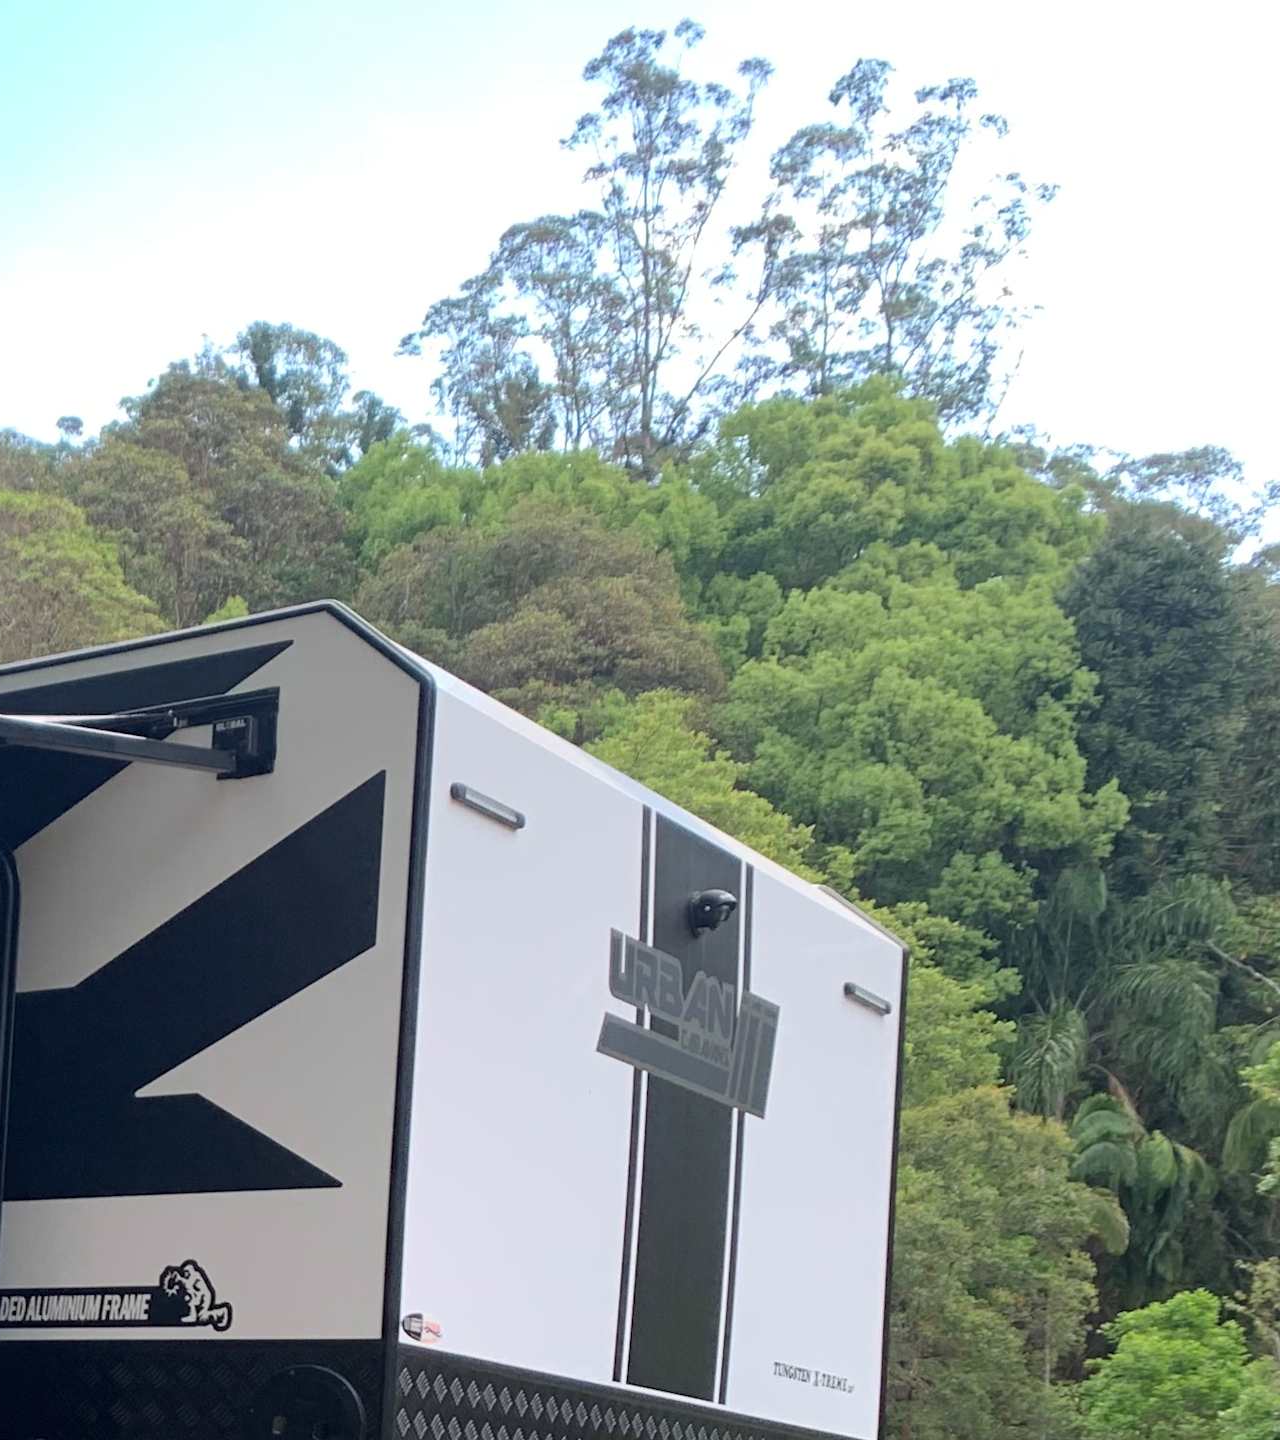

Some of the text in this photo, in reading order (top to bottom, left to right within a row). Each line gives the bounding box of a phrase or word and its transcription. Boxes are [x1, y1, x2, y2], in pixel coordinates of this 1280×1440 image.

[608, 927, 736, 1044] URBAN
[25, 1294, 103, 1321] ALUMINIUM
[101, 1293, 152, 1321] FRAME
[773, 1361, 811, 1383] TUNGSTEN
